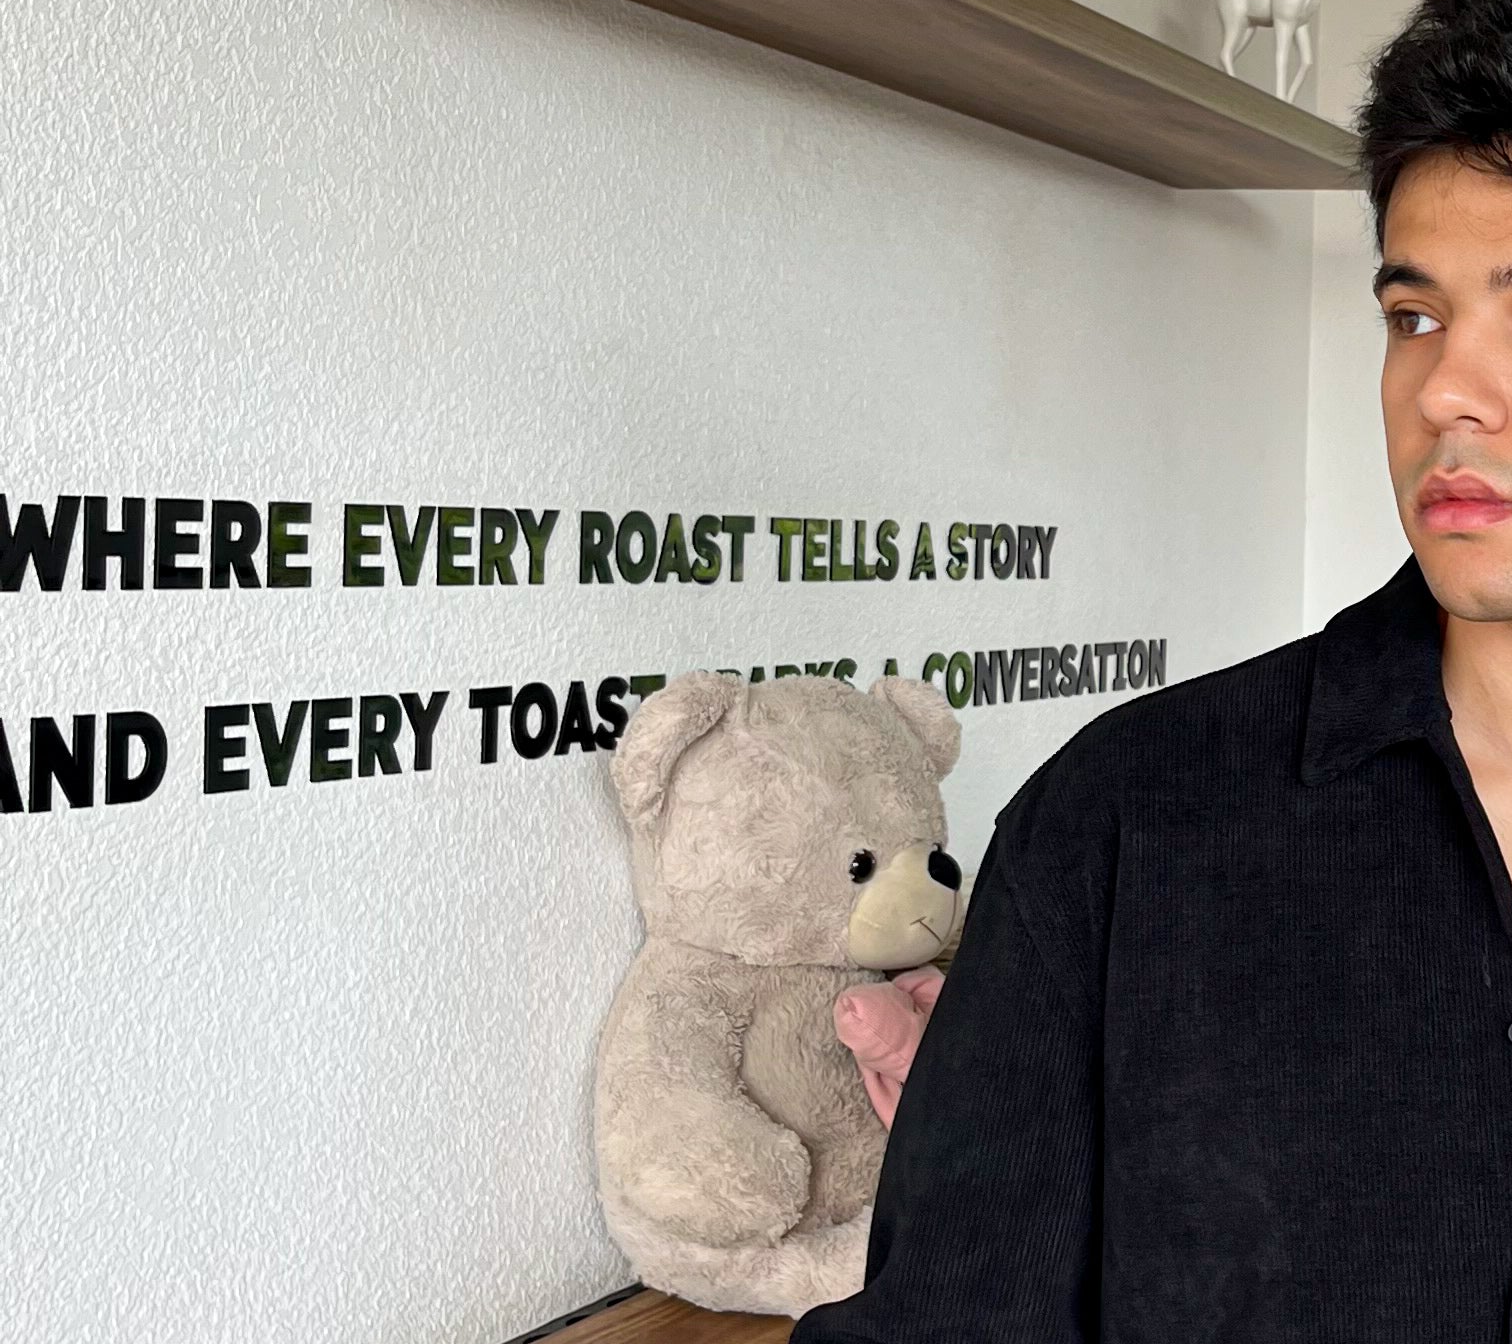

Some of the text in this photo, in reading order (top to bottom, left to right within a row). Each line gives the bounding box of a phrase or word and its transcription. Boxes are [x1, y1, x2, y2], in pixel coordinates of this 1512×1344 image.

[0, 493, 1058, 593] WHERE EVERY ROAST TELLS A STORY
[202, 690, 450, 795] EVERY
